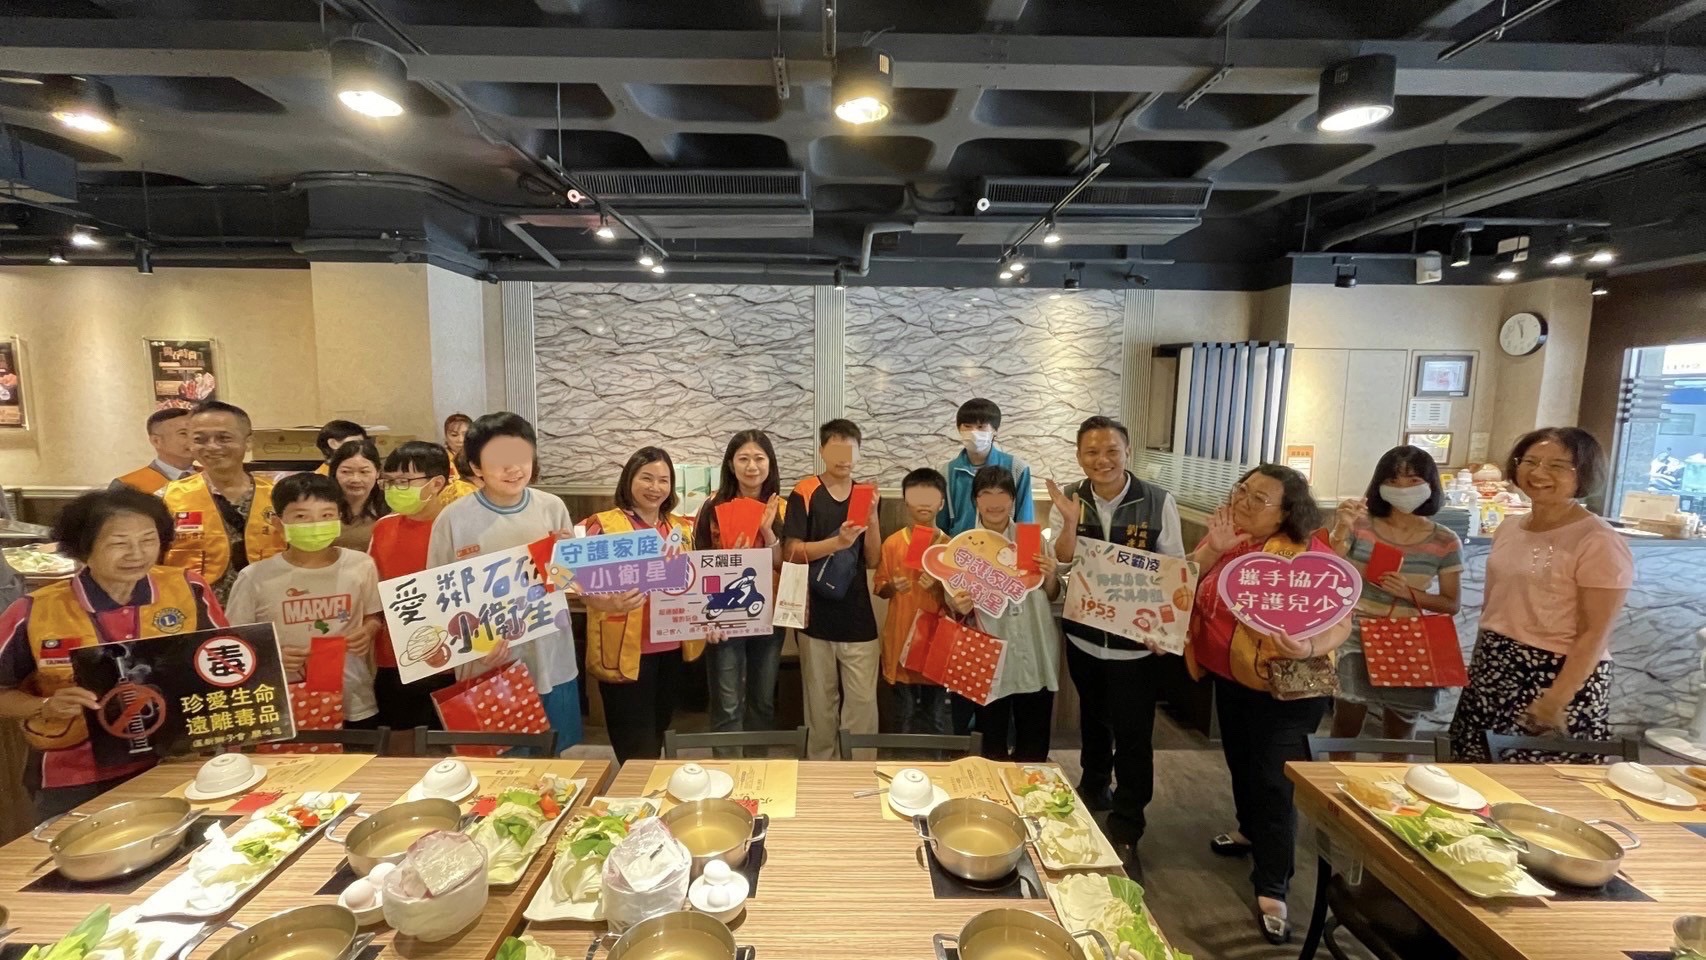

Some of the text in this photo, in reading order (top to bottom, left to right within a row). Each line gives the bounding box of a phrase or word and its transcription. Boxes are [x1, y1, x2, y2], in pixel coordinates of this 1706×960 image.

[561, 535, 659, 564] 守護家庭
[701, 553, 743, 568] 反飆車
[1117, 550, 1160, 573] 反霸凌
[590, 560, 667, 589] 小衛星
[955, 548, 1026, 600] 守護家庭
[1238, 568, 1339, 589] 攜手協力
[949, 572, 1003, 615] 小衛星
[1081, 597, 1117, 619] 1953
[1237, 590, 1338, 613] 守護兒少
[284, 595, 349, 623] MARVEL
[207, 644, 245, 676] 毒
[180, 684, 274, 714] 珍愛生命
[186, 705, 280, 736] 遠離毒品
